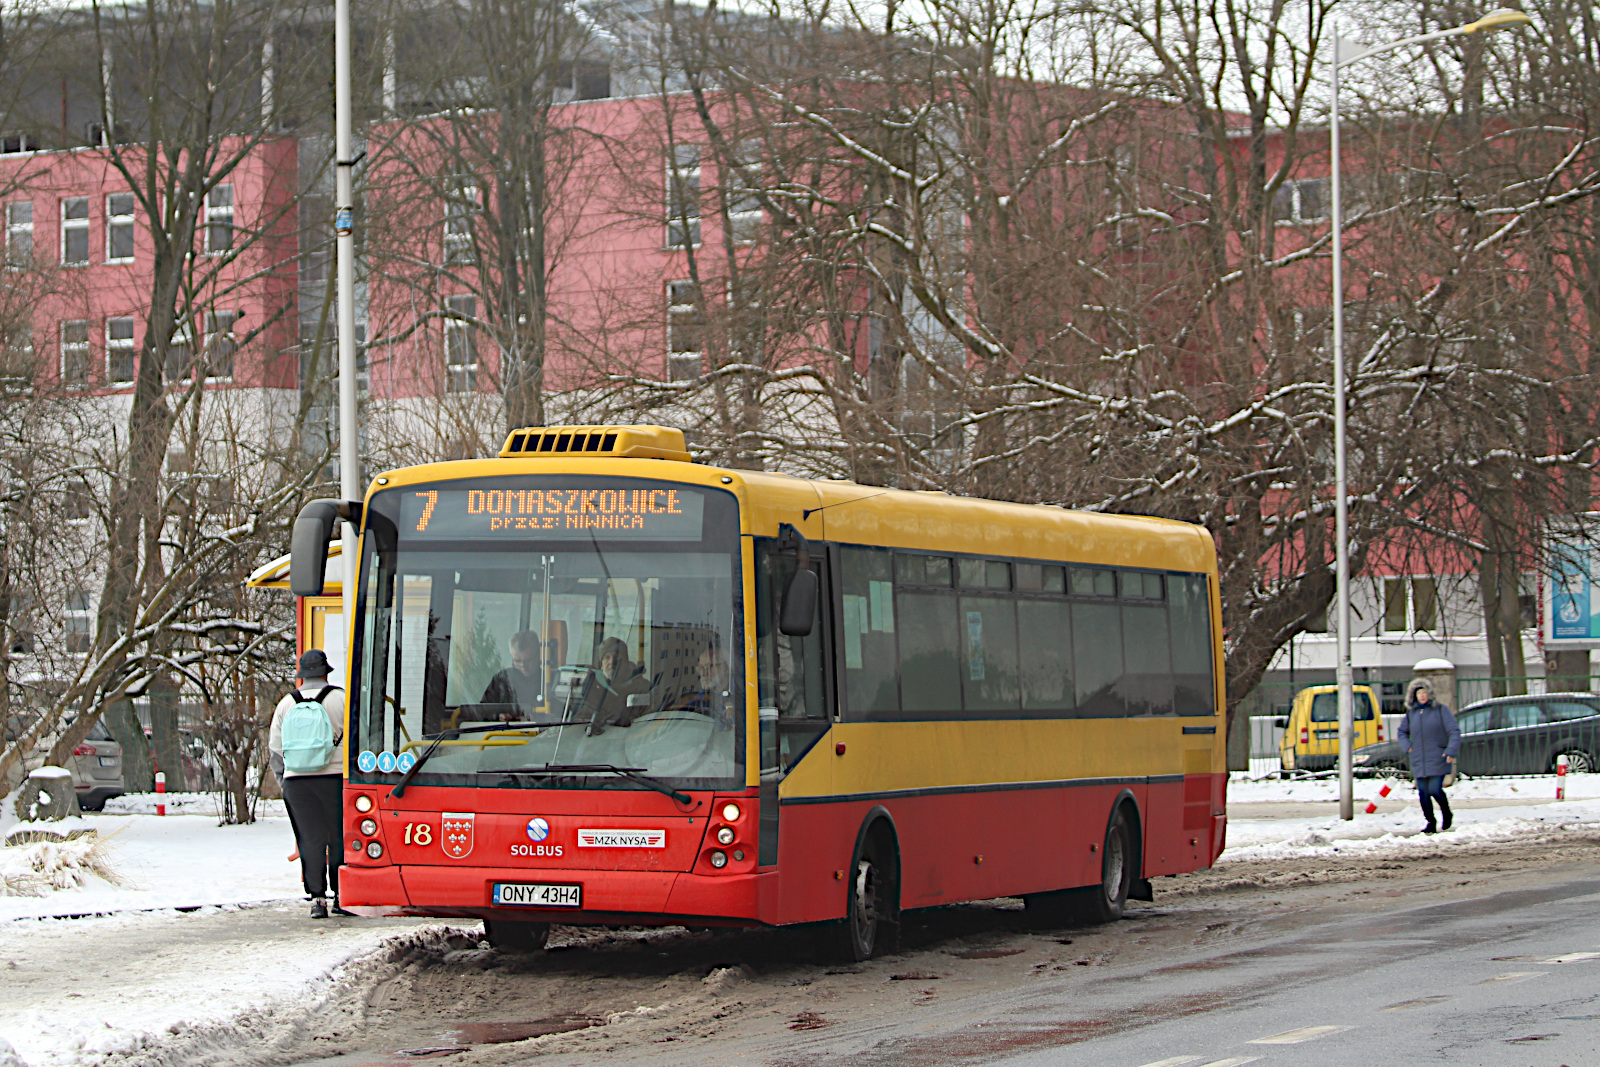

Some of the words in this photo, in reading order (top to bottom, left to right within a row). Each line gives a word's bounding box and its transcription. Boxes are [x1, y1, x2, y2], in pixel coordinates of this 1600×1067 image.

[415, 490, 438, 531] 7
[468, 490, 682, 514] DOMASZKOWICE
[491, 517, 559, 531] przez:
[566, 515, 644, 529] NIWNICA
[404, 823, 433, 846] 18
[594, 836, 618, 845] MZK
[619, 836, 648, 846] NYSA
[510, 844, 563, 857] SOLBUS
[502, 886, 536, 902] ONY
[541, 887, 578, 903] 43H4
